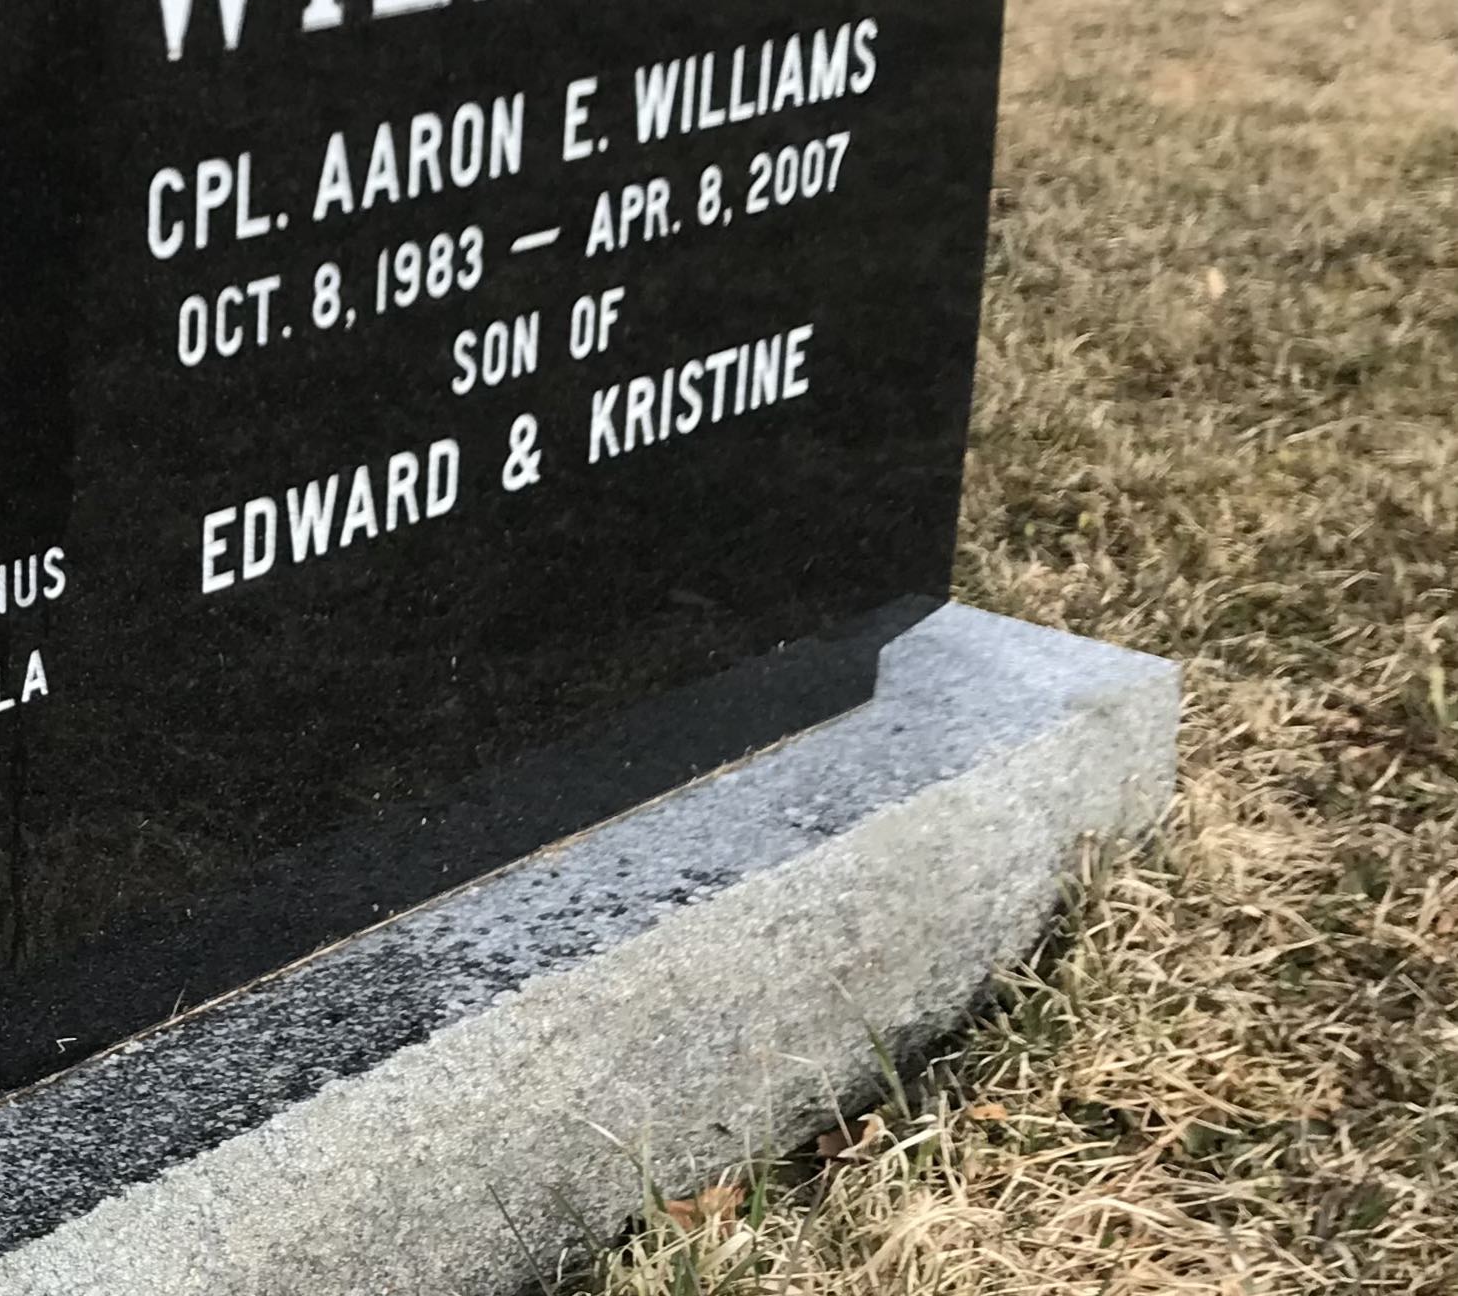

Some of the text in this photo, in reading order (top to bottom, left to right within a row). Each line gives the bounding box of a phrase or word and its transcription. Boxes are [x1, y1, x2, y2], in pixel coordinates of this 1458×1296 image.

[145, 16, 880, 261] CPL. AARON E. WILLIAMS
[175, 273, 294, 369] OCT.
[373, 223, 486, 316] 1983
[583, 175, 683, 260] APR.
[743, 129, 853, 216] 2007
[199, 321, 816, 597] EDWARD & KRISTINE
[449, 284, 627, 397] SON OF
